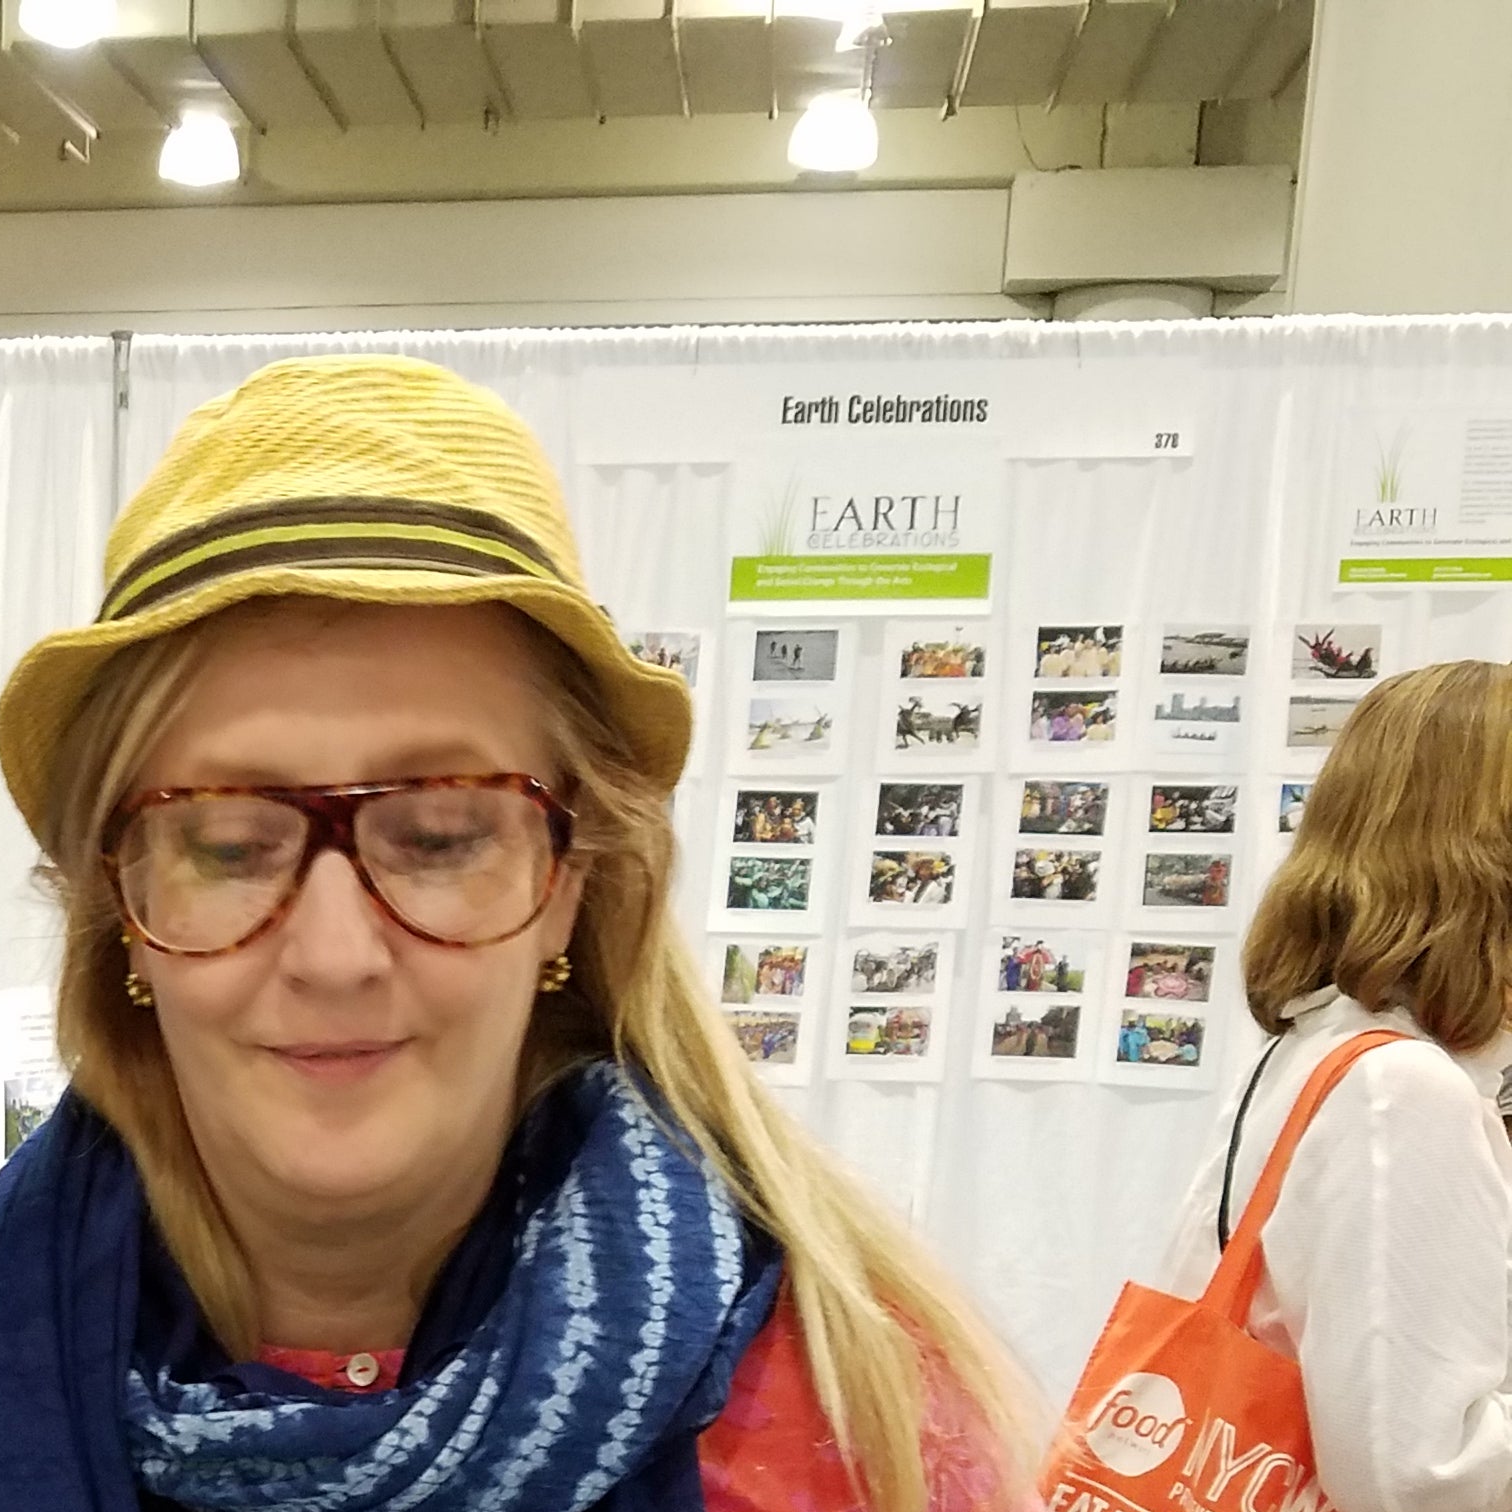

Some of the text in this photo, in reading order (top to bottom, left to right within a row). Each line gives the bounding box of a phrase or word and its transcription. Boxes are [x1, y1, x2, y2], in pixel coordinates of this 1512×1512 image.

[781, 394, 989, 424] Earth Celebrations
[1154, 432, 1179, 449] 378
[811, 494, 961, 531] EARTH
[1356, 508, 1437, 526] EARTH
[807, 531, 960, 549] CELEBRATIONS
[1086, 1389, 1193, 1448] food
